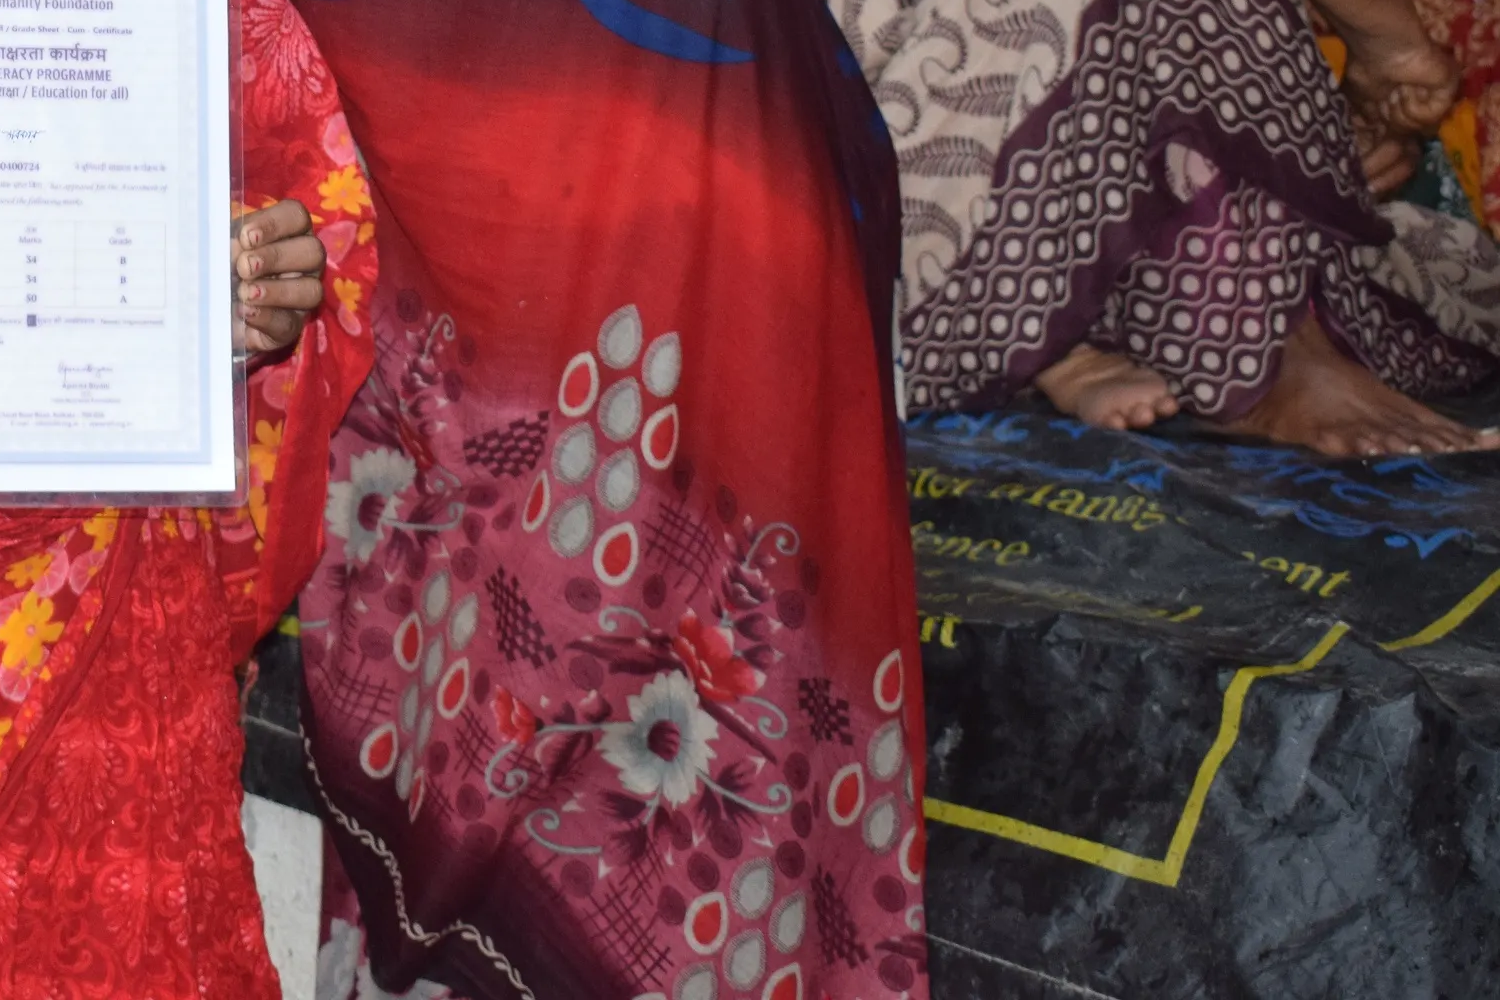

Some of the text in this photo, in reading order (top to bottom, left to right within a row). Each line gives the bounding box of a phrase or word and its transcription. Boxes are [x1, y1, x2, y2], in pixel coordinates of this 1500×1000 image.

[49, 41, 108, 62] कार्यक्रम
[36, 68, 113, 82] PROGRAMME
[31, 85, 89, 100] Education
[91, 85, 108, 100] for
[110, 86, 130, 101] all)
[119, 295, 128, 304] A
